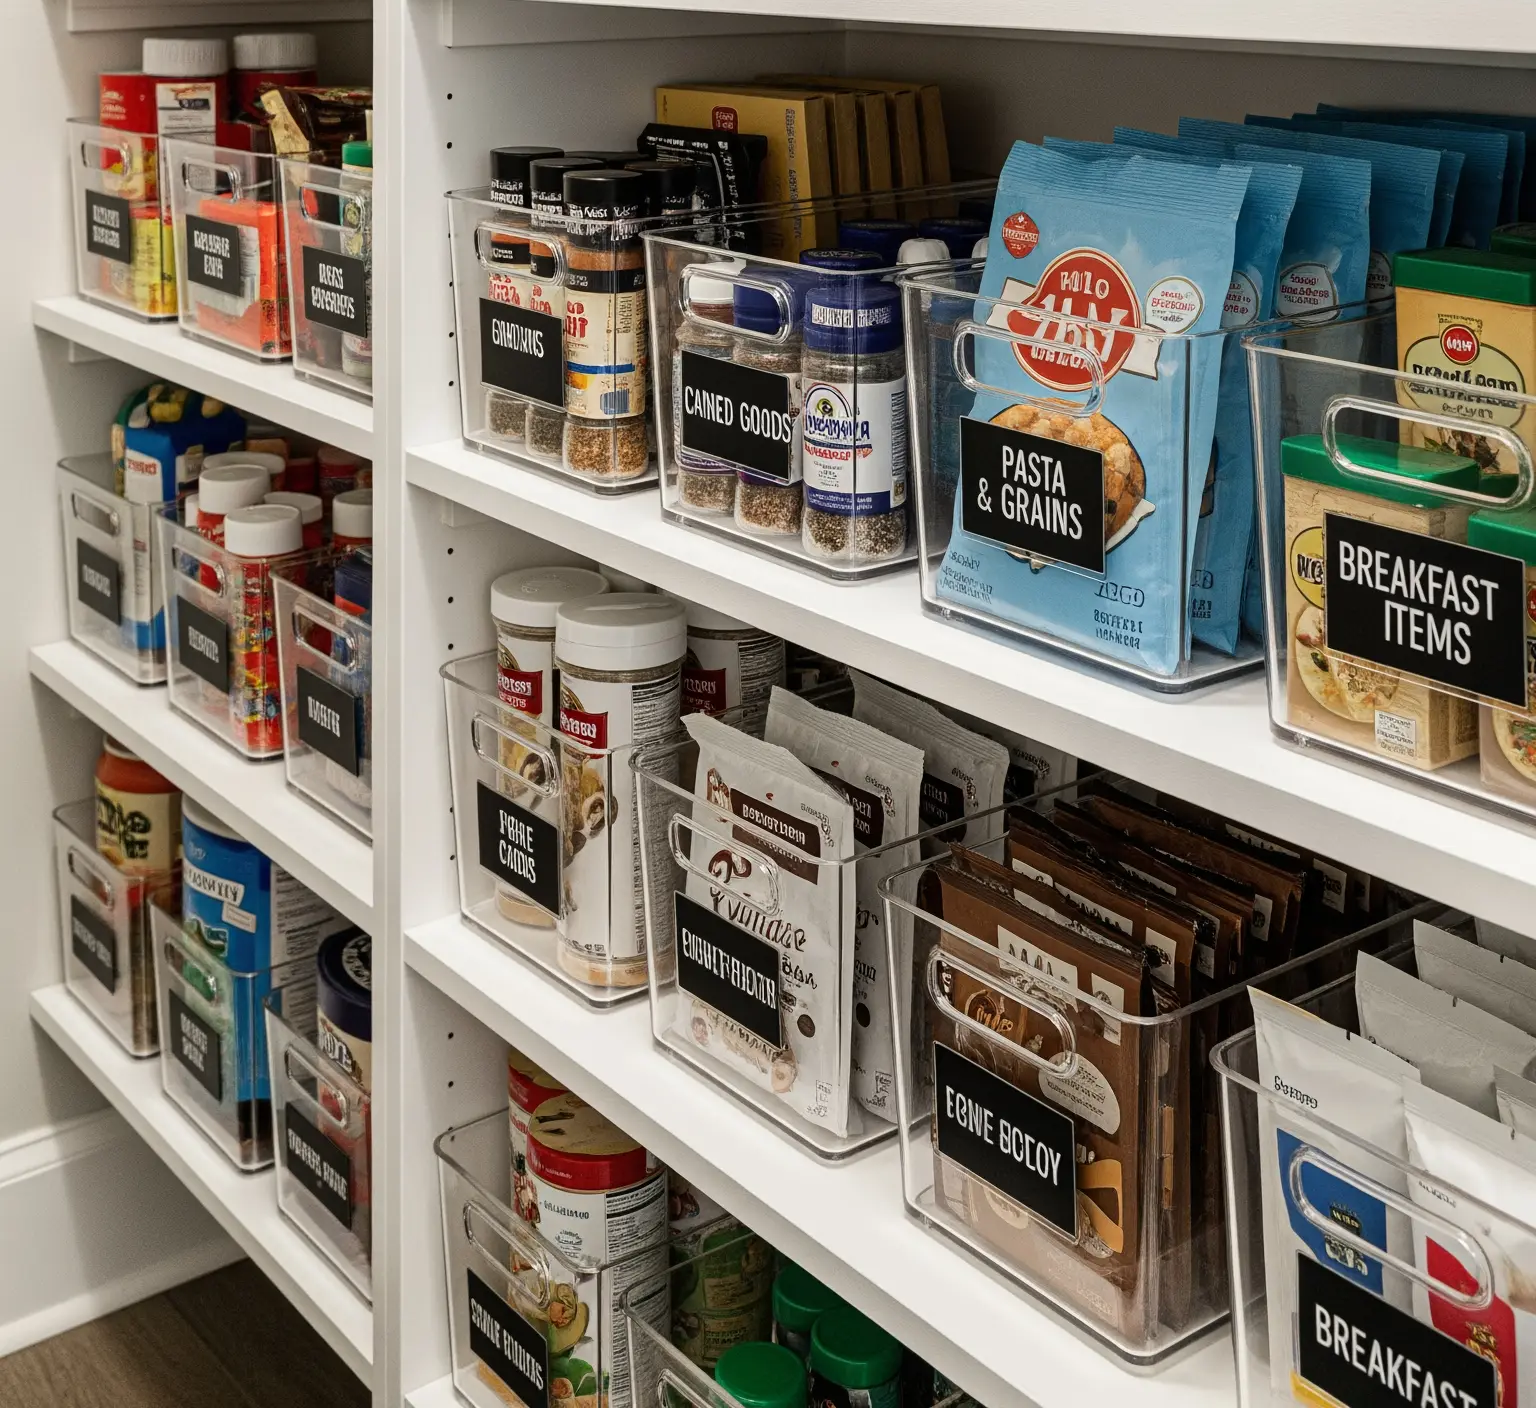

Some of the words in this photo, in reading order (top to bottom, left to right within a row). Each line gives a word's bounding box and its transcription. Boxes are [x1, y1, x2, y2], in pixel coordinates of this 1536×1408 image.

[739, 402, 792, 443] GOODS
[1002, 445, 1066, 497] PASTA
[977, 477, 992, 513] &
[1001, 483, 1083, 540] GRAINS
[1339, 540, 1499, 621] BREAKFAST
[1384, 600, 1472, 665] ITEMS
